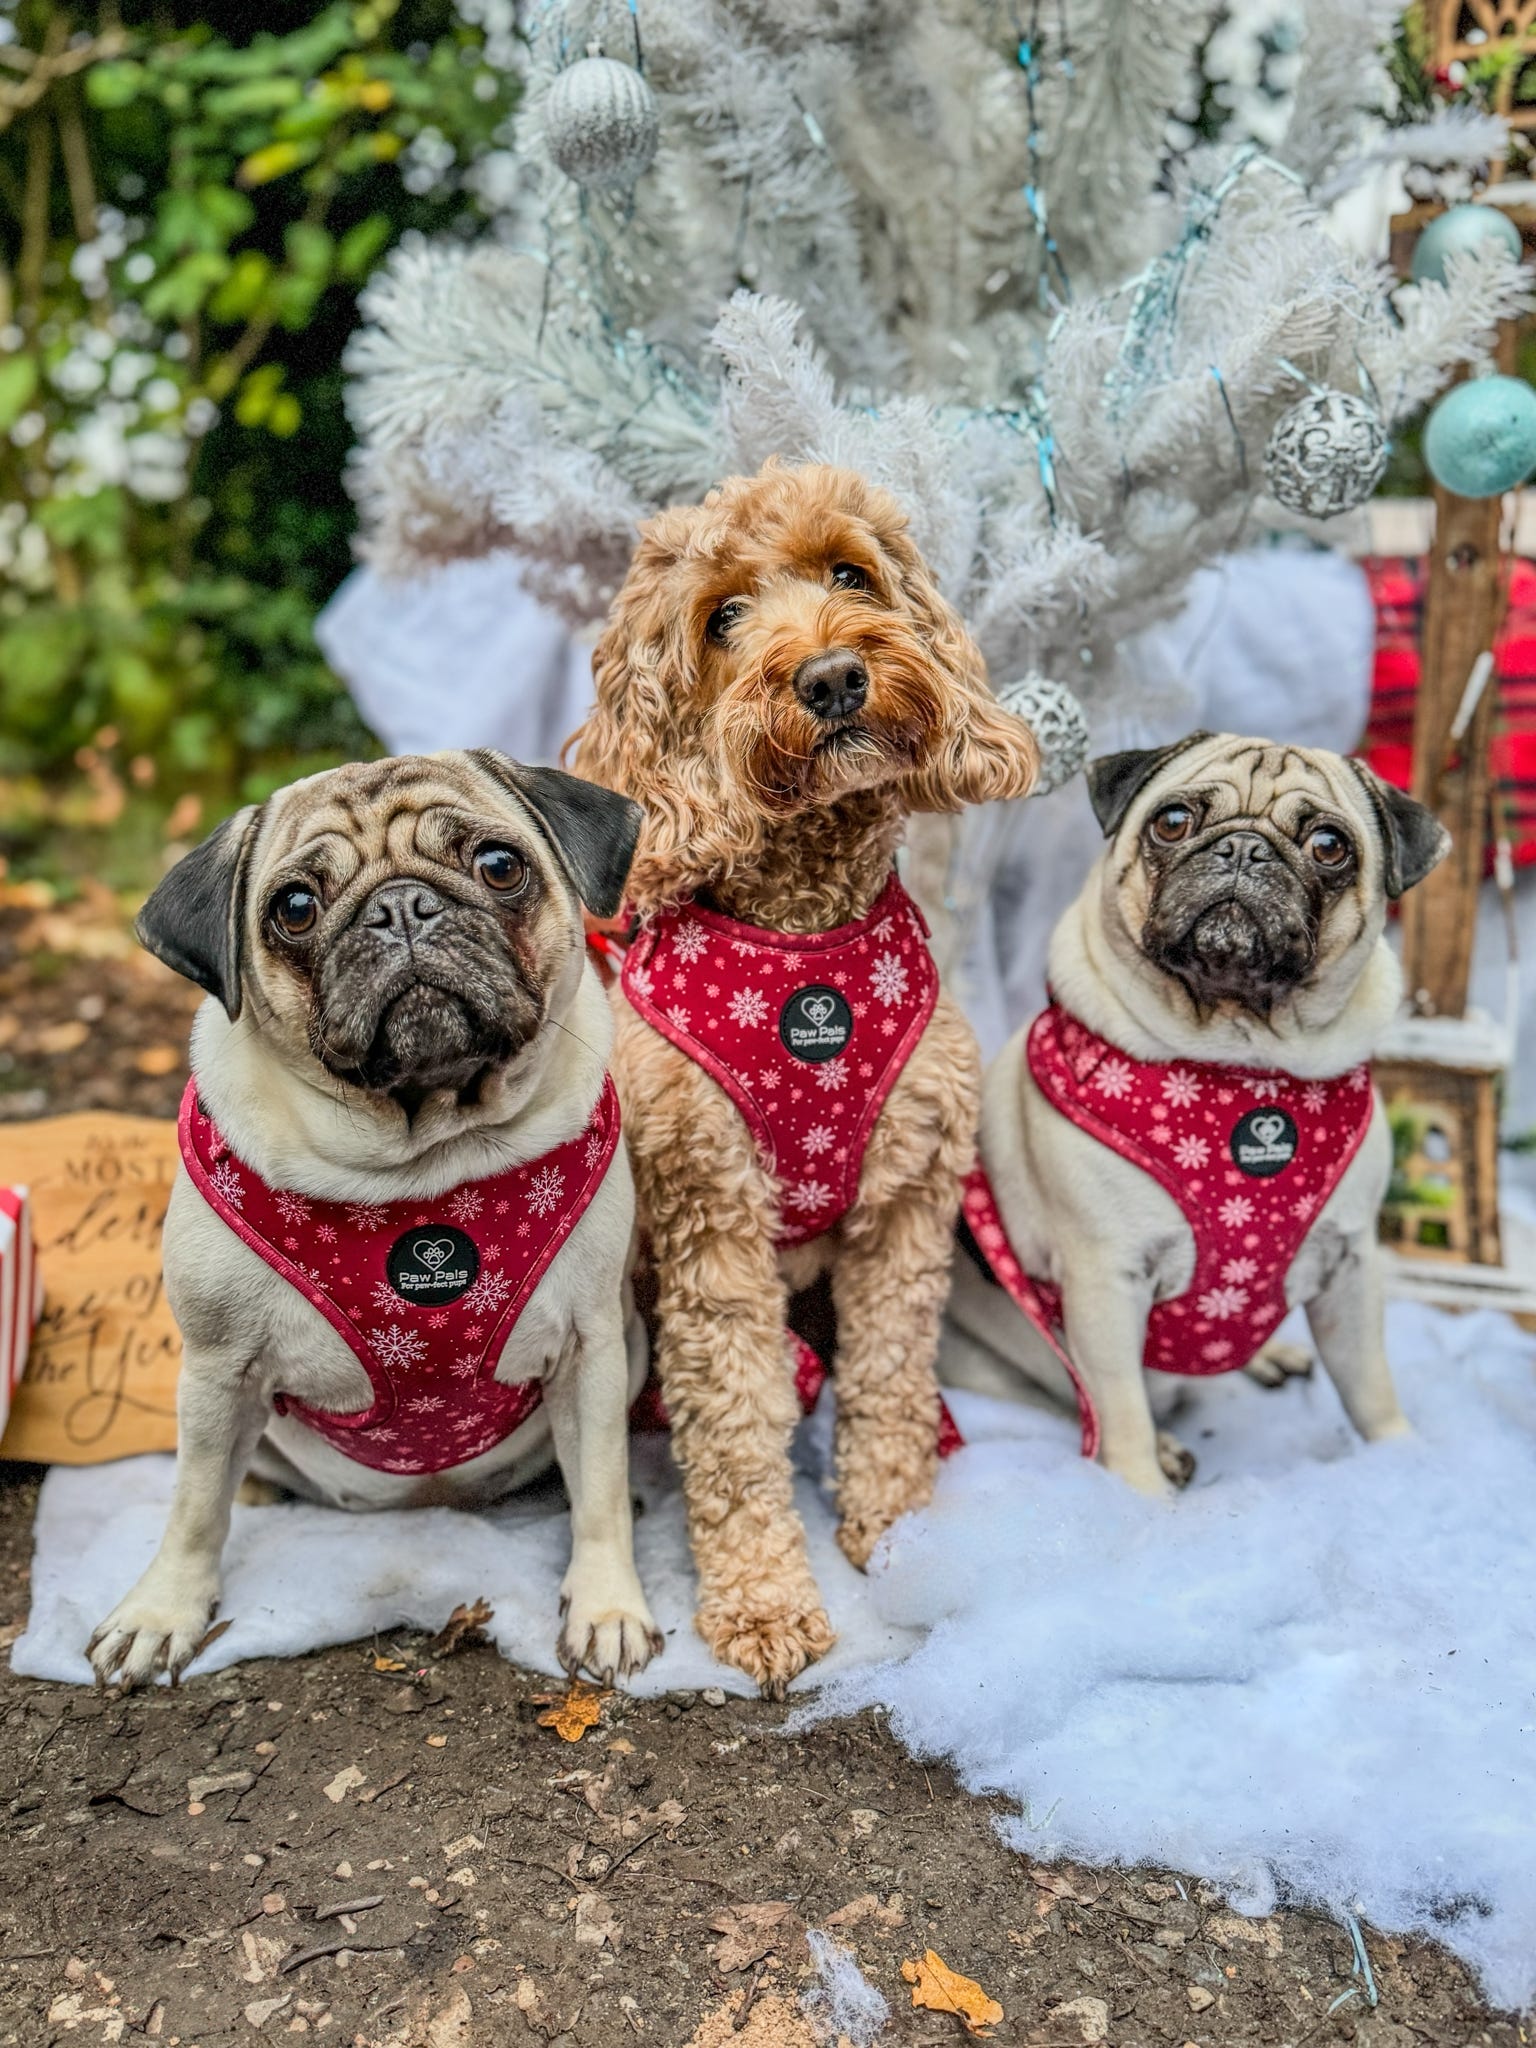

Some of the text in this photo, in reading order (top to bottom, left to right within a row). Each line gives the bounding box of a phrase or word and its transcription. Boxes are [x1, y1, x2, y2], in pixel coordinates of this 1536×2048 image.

[791, 1025, 846, 1038] Paw Pals
[65, 1156, 175, 1185] MOST
[399, 1269, 468, 1283] Paw Pals
